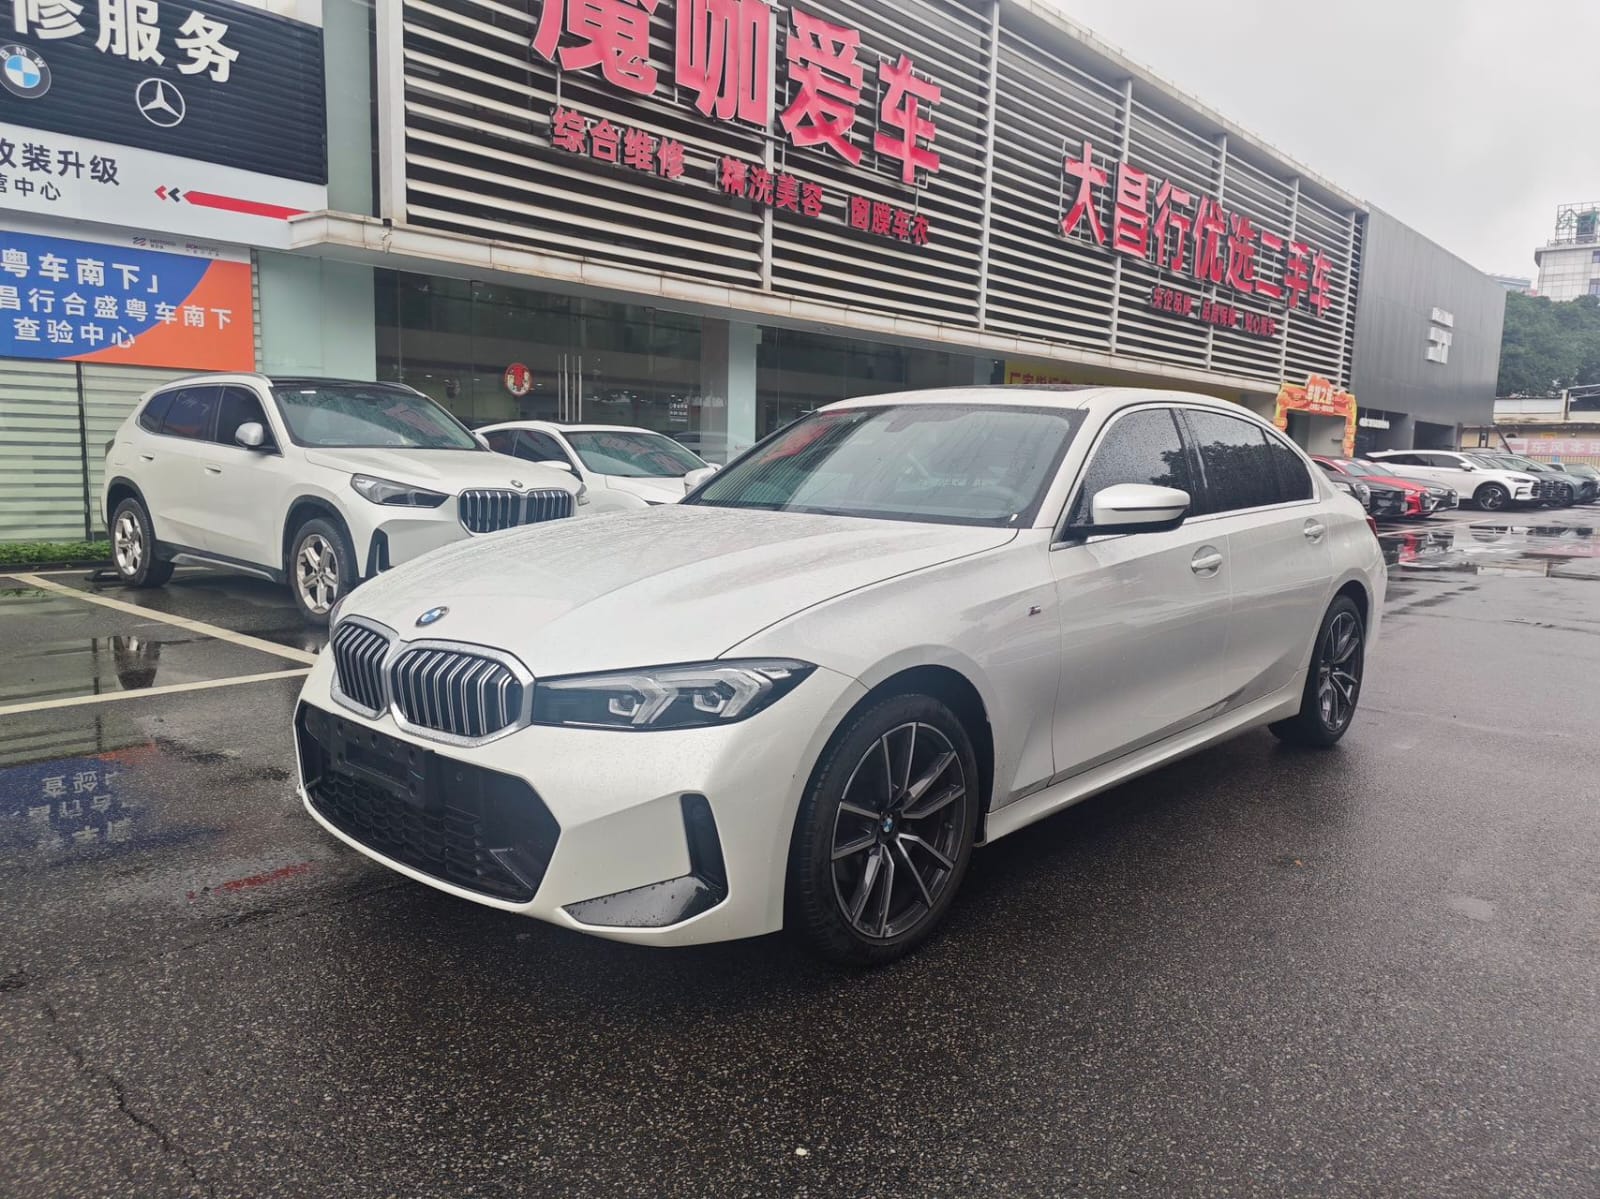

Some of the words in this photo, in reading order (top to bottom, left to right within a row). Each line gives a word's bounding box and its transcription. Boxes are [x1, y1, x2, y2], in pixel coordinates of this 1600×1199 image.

[552, 105, 686, 180] 综合维修
[721, 155, 823, 218] 精洗美容
[1060, 140, 1333, 317] 大昌行优选二手车
[0, 285, 232, 330] 昌行合盛粤车南下
[13, 317, 136, 349] 查验中心
